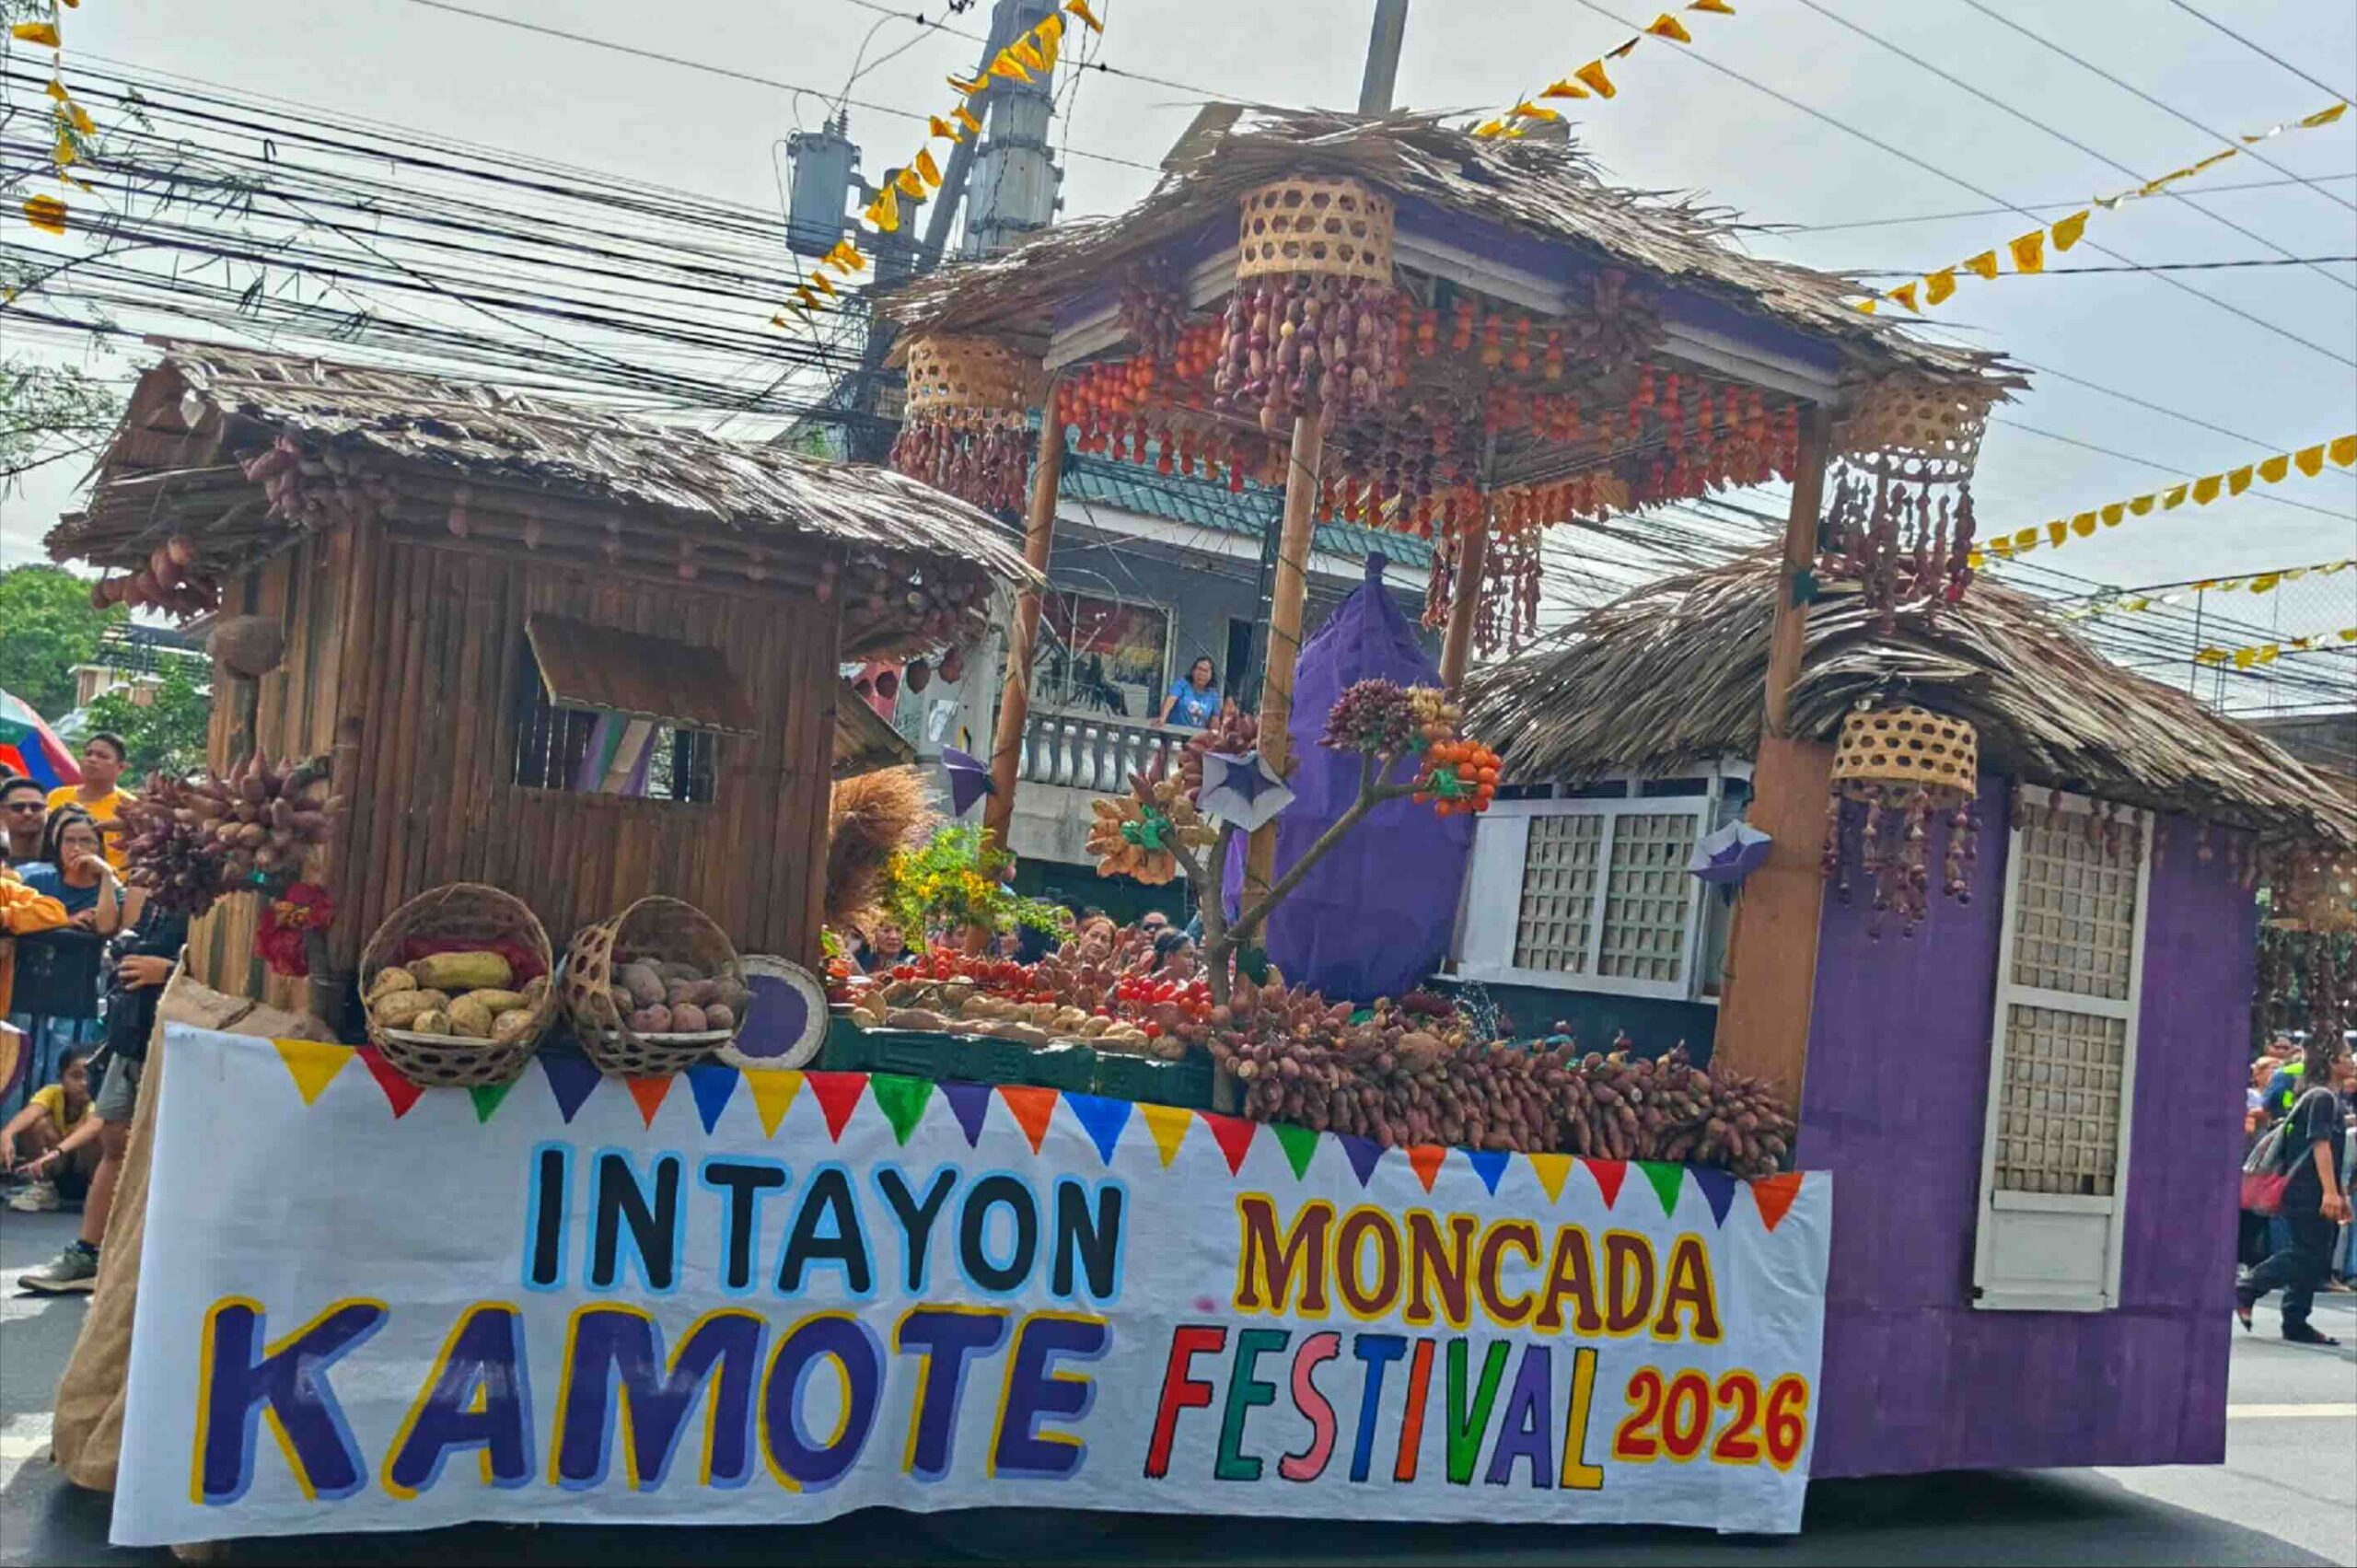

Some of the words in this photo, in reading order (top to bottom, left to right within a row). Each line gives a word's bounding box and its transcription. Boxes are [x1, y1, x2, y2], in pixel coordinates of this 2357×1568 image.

[521, 1142, 1126, 1300] INTAYON
[1233, 1191, 1724, 1345] MONCADA
[187, 1295, 1114, 1504] KAMOTE
[1143, 1324, 1606, 1492] FESTIVAL
[1611, 1365, 1810, 1471] 2026
